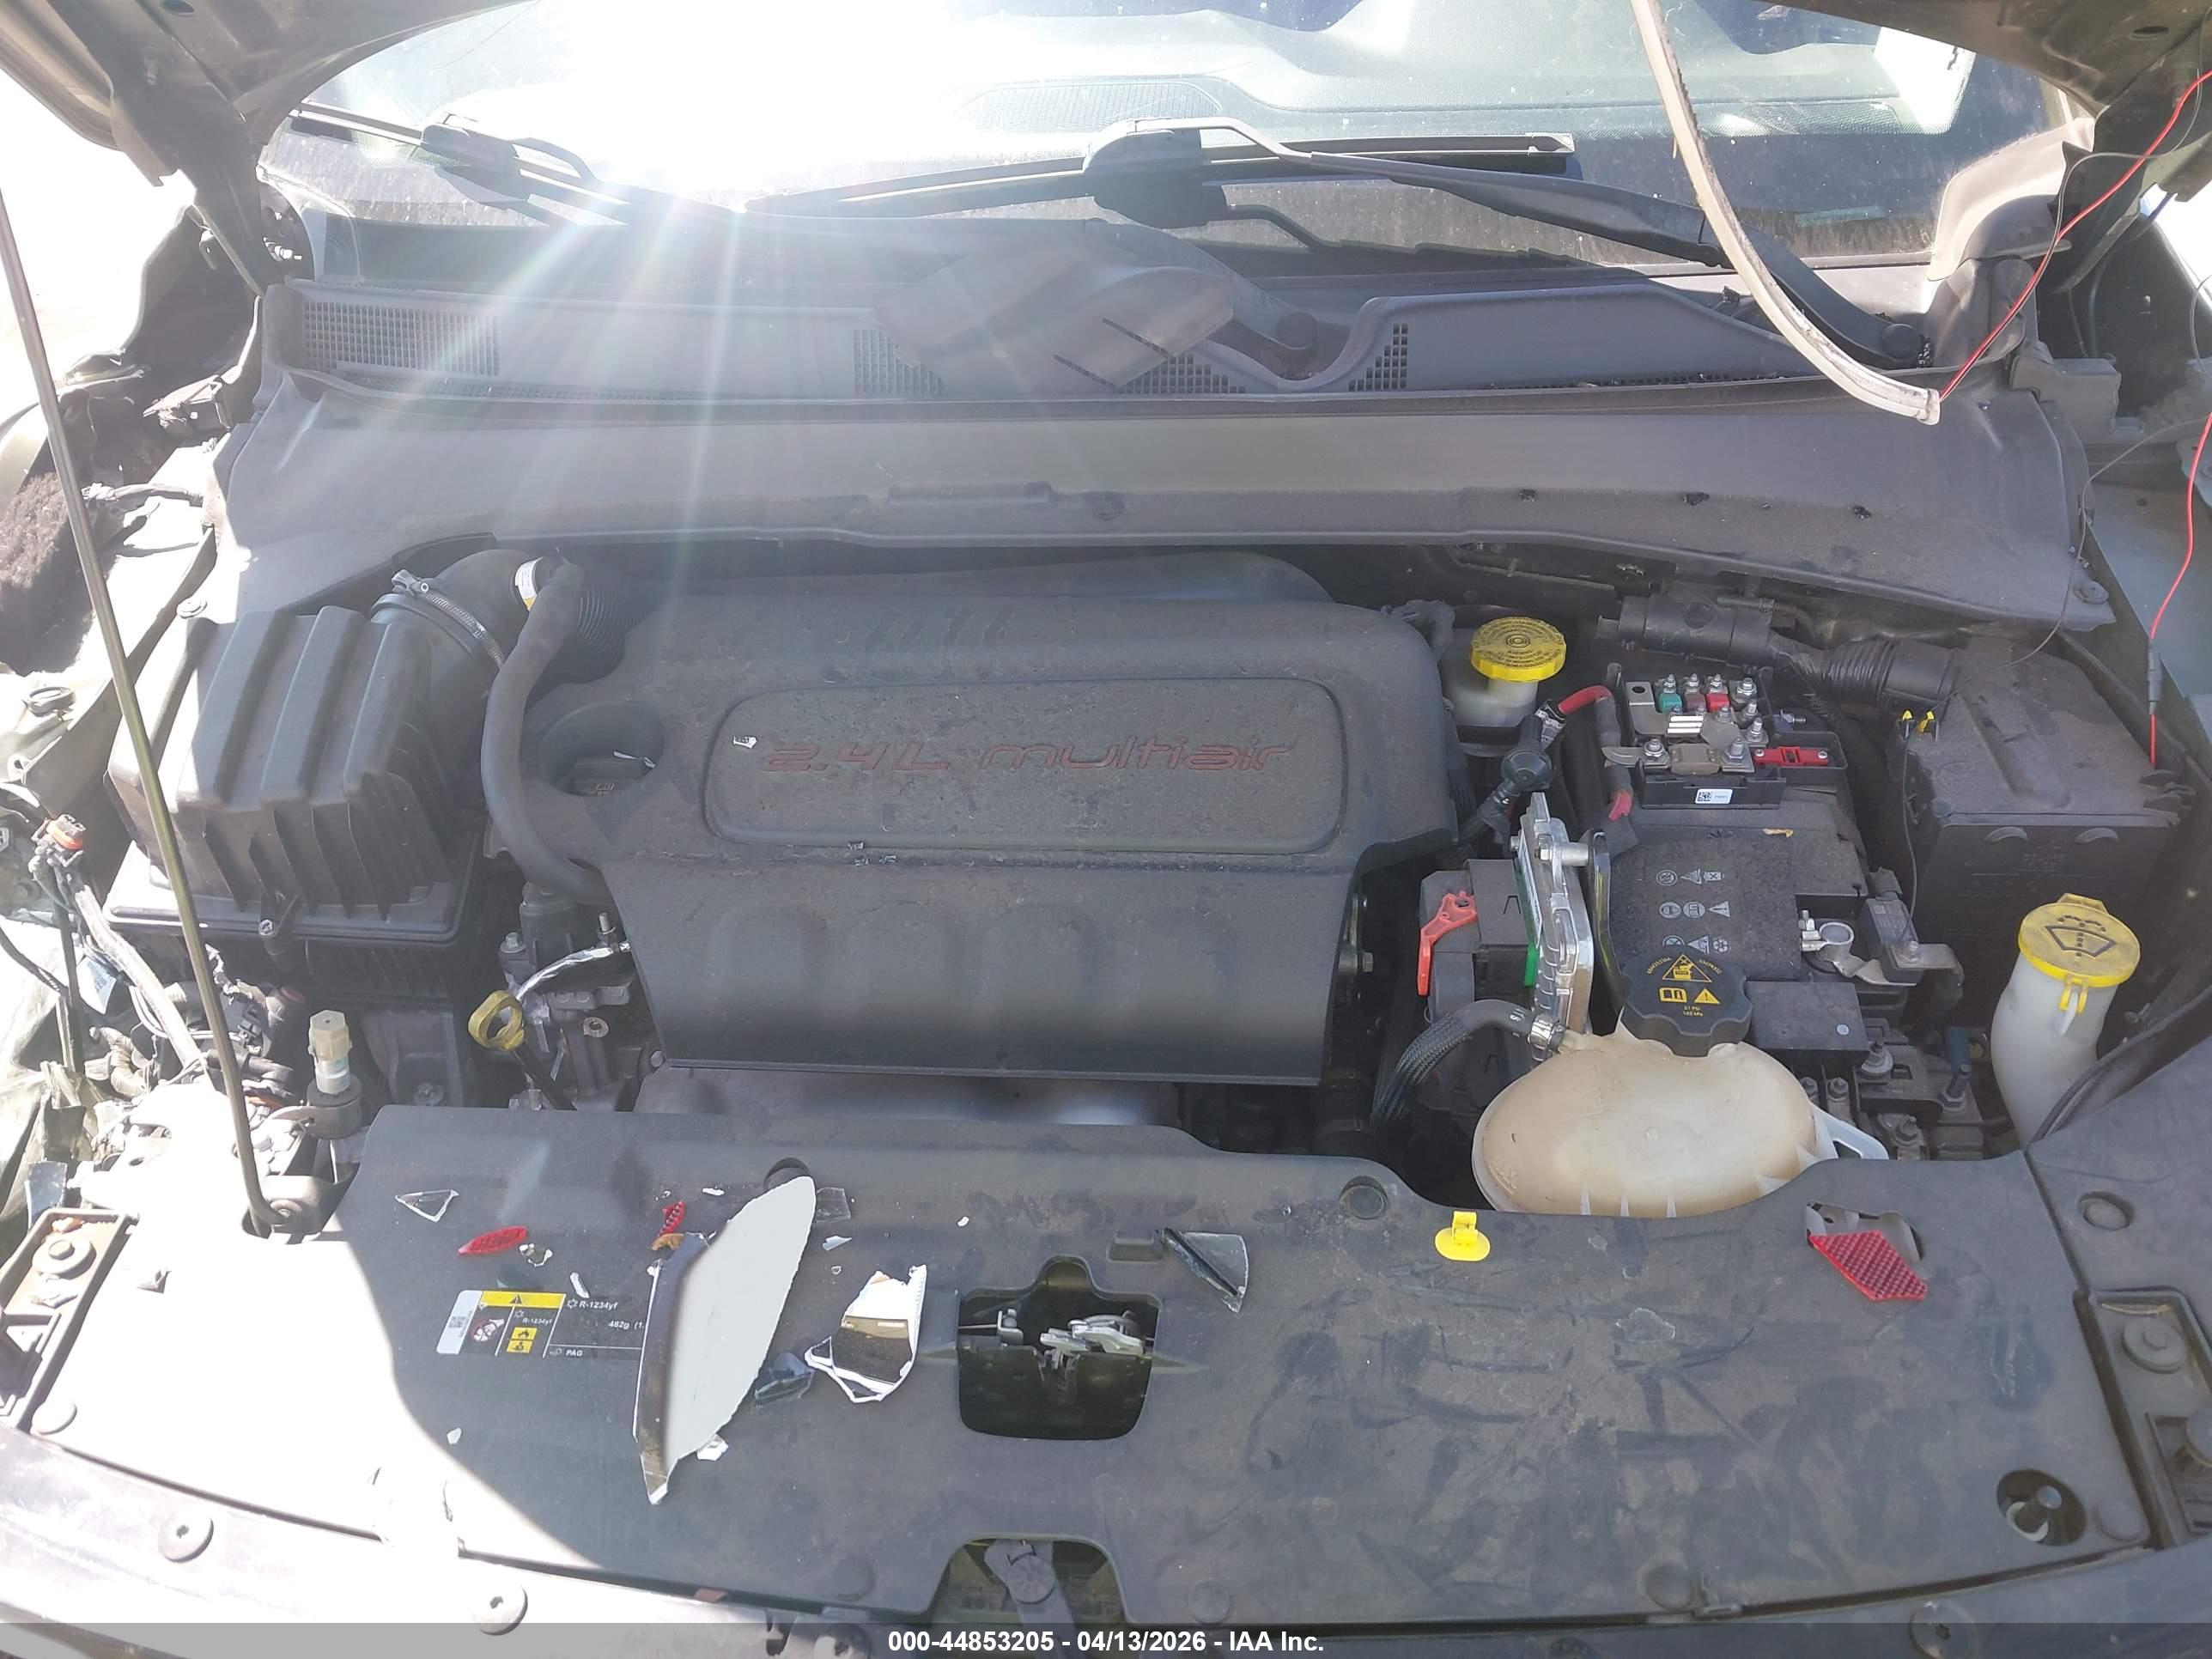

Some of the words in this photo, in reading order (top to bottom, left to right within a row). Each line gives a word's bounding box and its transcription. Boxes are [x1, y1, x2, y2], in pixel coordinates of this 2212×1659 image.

[764, 742, 951, 770] 2.4L
[983, 734, 1293, 770] multiair
[579, 1300, 618, 1310] R-1234yf
[634, 1321, 645, 1330] (1.
